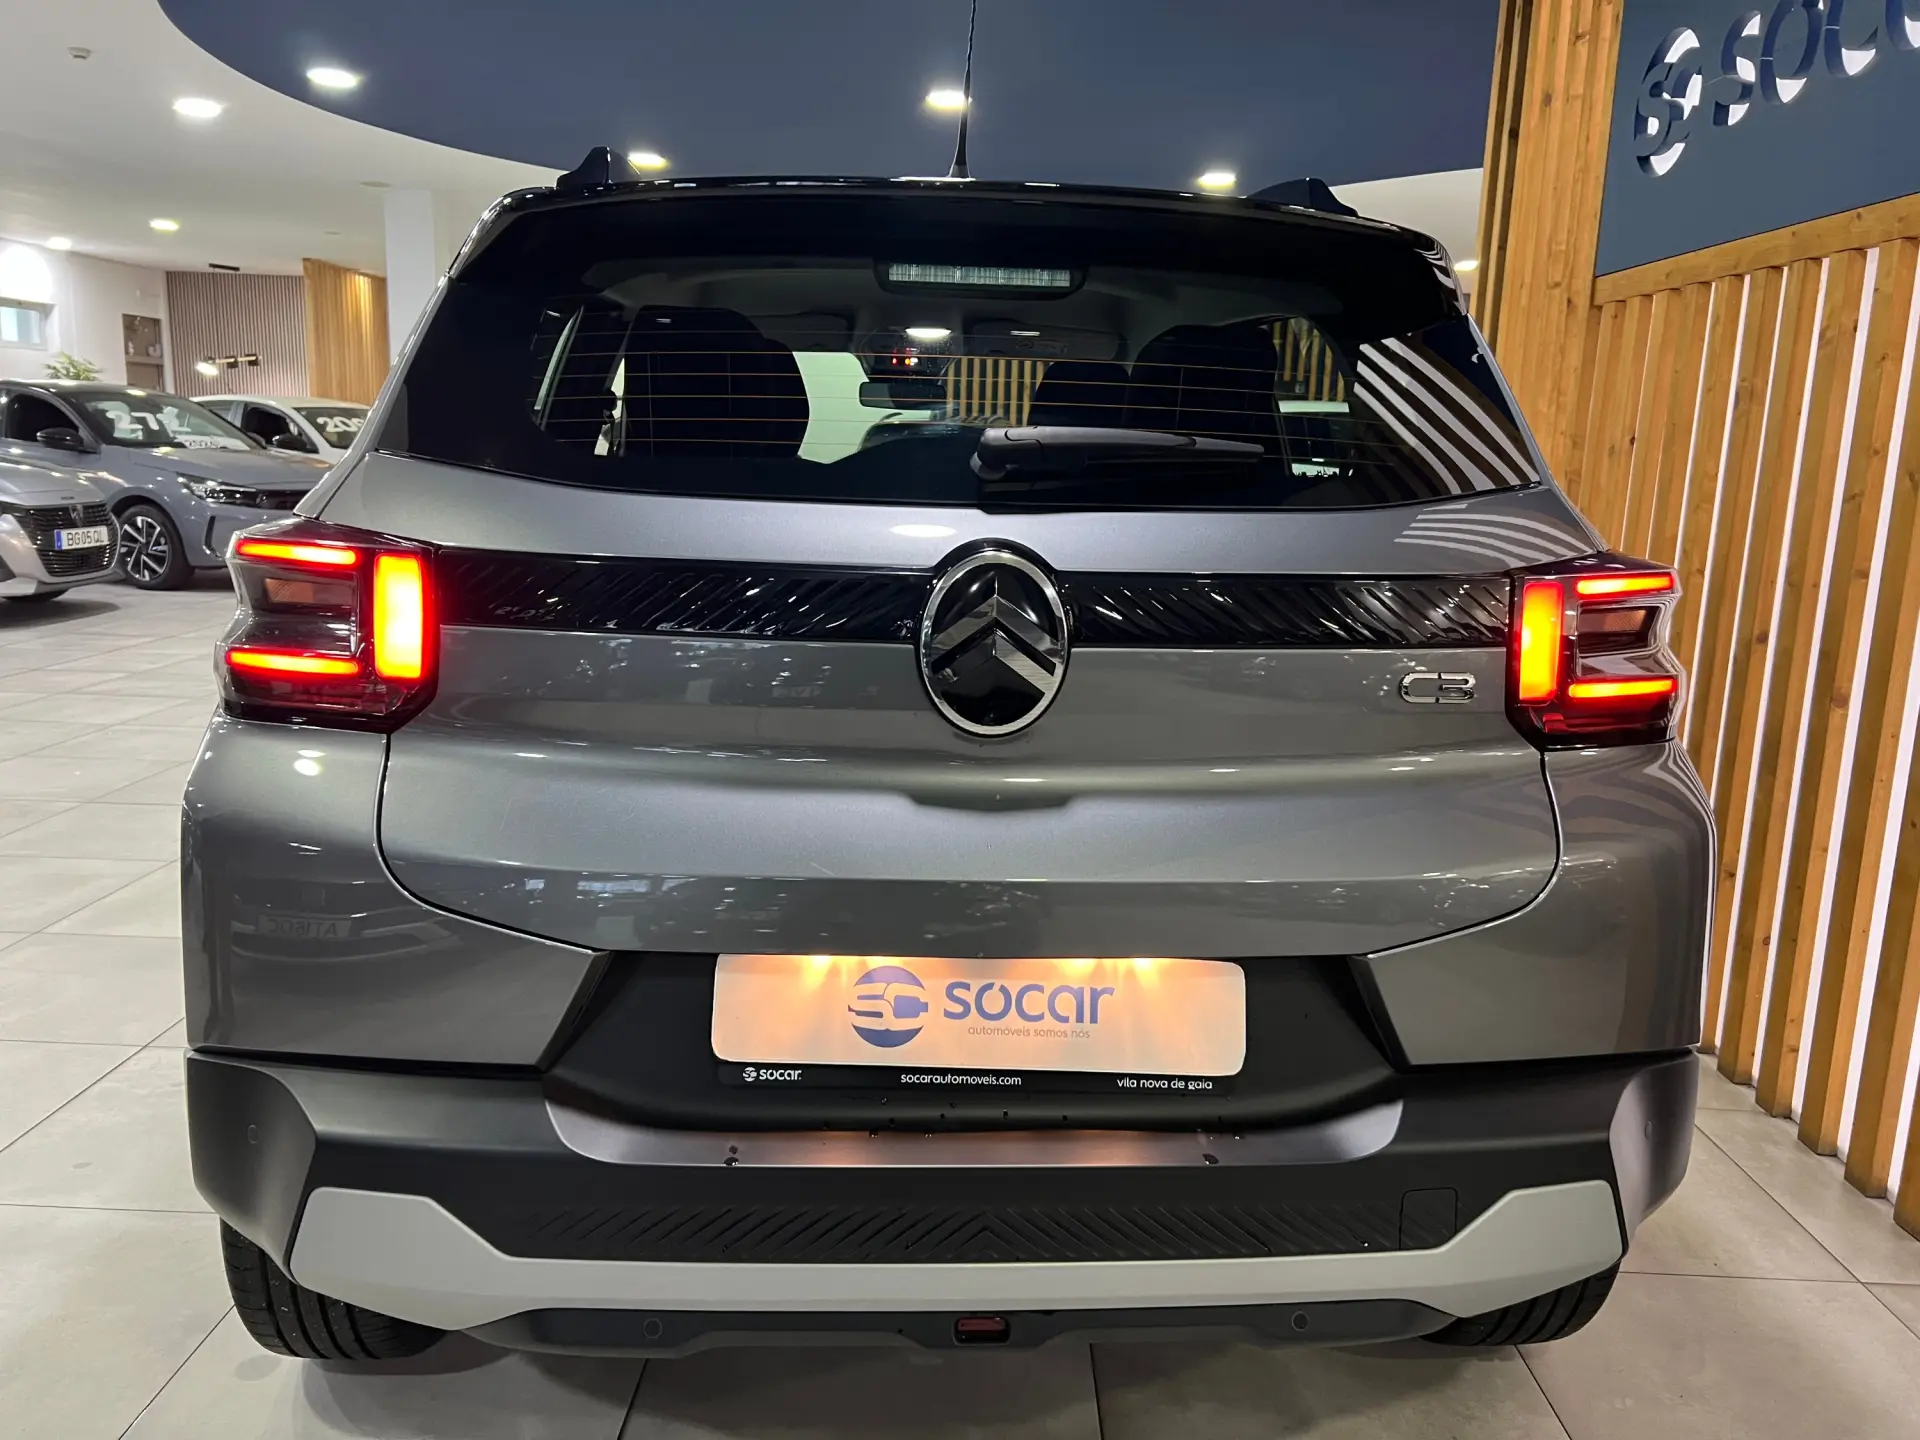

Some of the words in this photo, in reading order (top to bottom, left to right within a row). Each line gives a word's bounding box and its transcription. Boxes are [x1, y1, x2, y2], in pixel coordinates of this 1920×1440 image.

[1399, 671, 1476, 704] C3
[943, 980, 1115, 1024] socar
[967, 1025, 1031, 1038] automóveis
[1033, 1028, 1068, 1039] somos
[900, 1073, 1022, 1086] socarautomoveis.com
[1116, 1077, 1137, 1088] vila
[1139, 1079, 1169, 1089] nova
[1170, 1077, 1186, 1089] de
[1187, 1078, 1213, 1091] gaia
